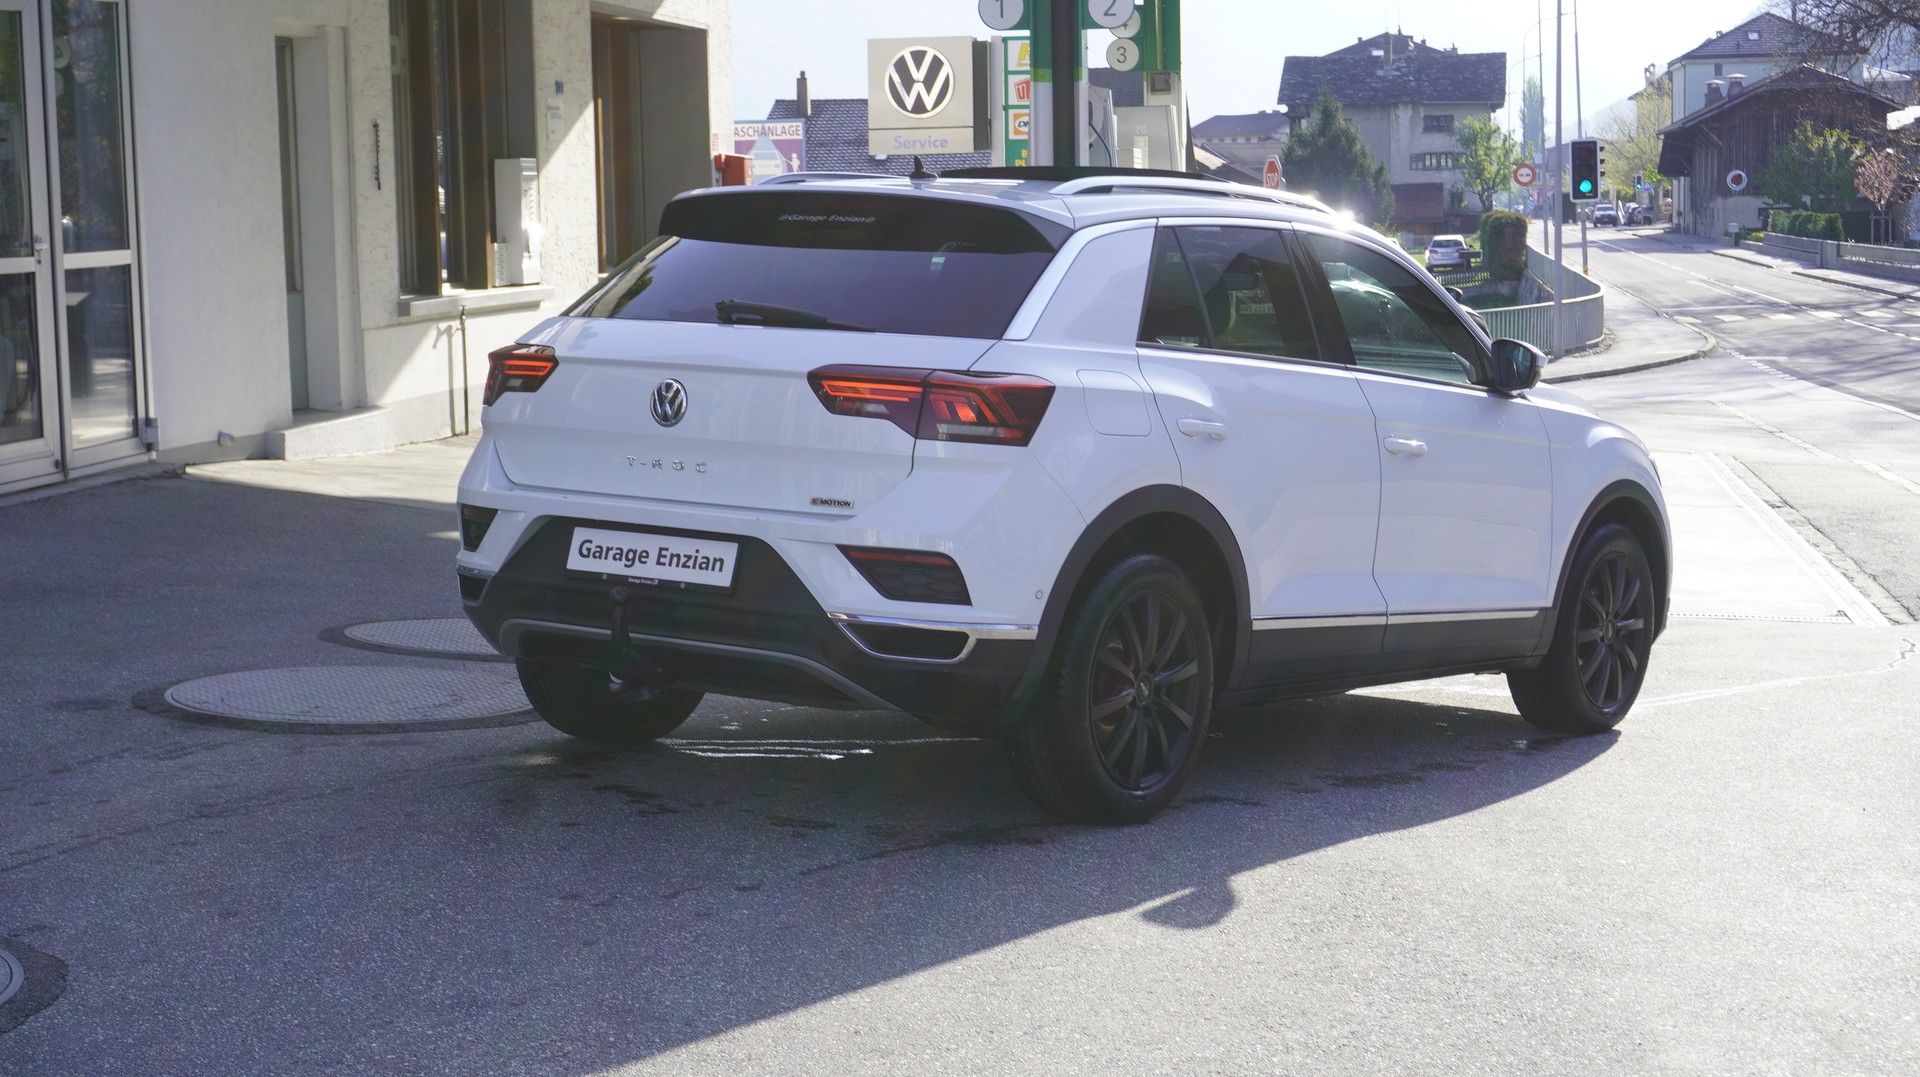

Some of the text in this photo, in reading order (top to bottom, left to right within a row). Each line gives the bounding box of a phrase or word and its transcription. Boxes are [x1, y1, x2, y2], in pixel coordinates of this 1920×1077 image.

[1103, 0, 1117, 17] 2
[1116, 46, 1127, 64] 3
[734, 124, 801, 138] ASCHANLAGE
[894, 135, 949, 149] Service
[578, 539, 725, 573] Garage Enzian
